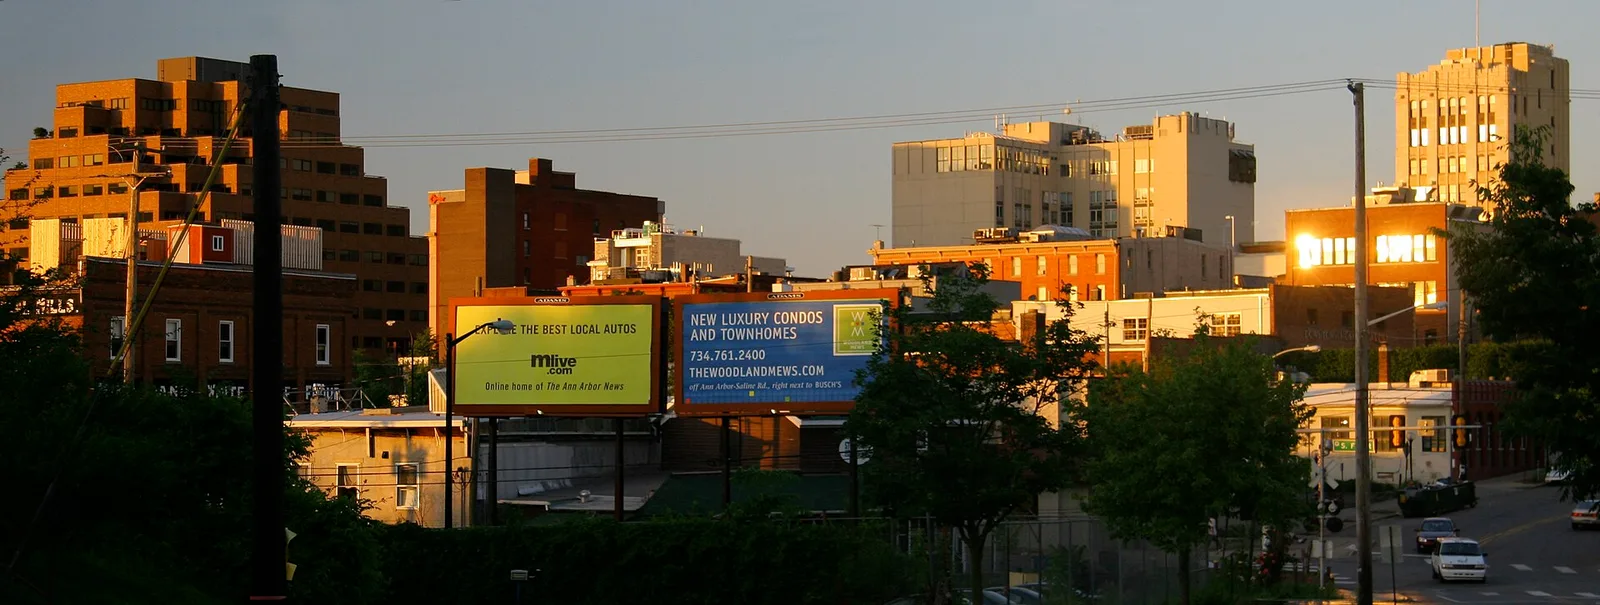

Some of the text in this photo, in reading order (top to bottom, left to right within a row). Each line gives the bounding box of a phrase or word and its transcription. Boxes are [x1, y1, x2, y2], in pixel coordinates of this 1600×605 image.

[691, 311, 823, 326] NEW LUXURY CONDOS
[475, 323, 637, 335] EXPLE THE BEST LOCAL AUTOS
[690, 326, 797, 341] AND TOWNHOMES
[690, 350, 766, 361] 734.761.2400
[546, 367, 573, 375] .com
[689, 365, 824, 378] THEWOODLANDMEWS.COM
[485, 381, 624, 391] Online home of The Ann Arbor News
[689, 382, 700, 391] off
[715, 382, 755, 390] Arbor-Saline
[757, 382, 770, 391] Rd.,
[772, 381, 788, 391] right
[789, 382, 804, 390] next
[805, 381, 813, 389] to
[815, 381, 842, 389] BUSCH'S
